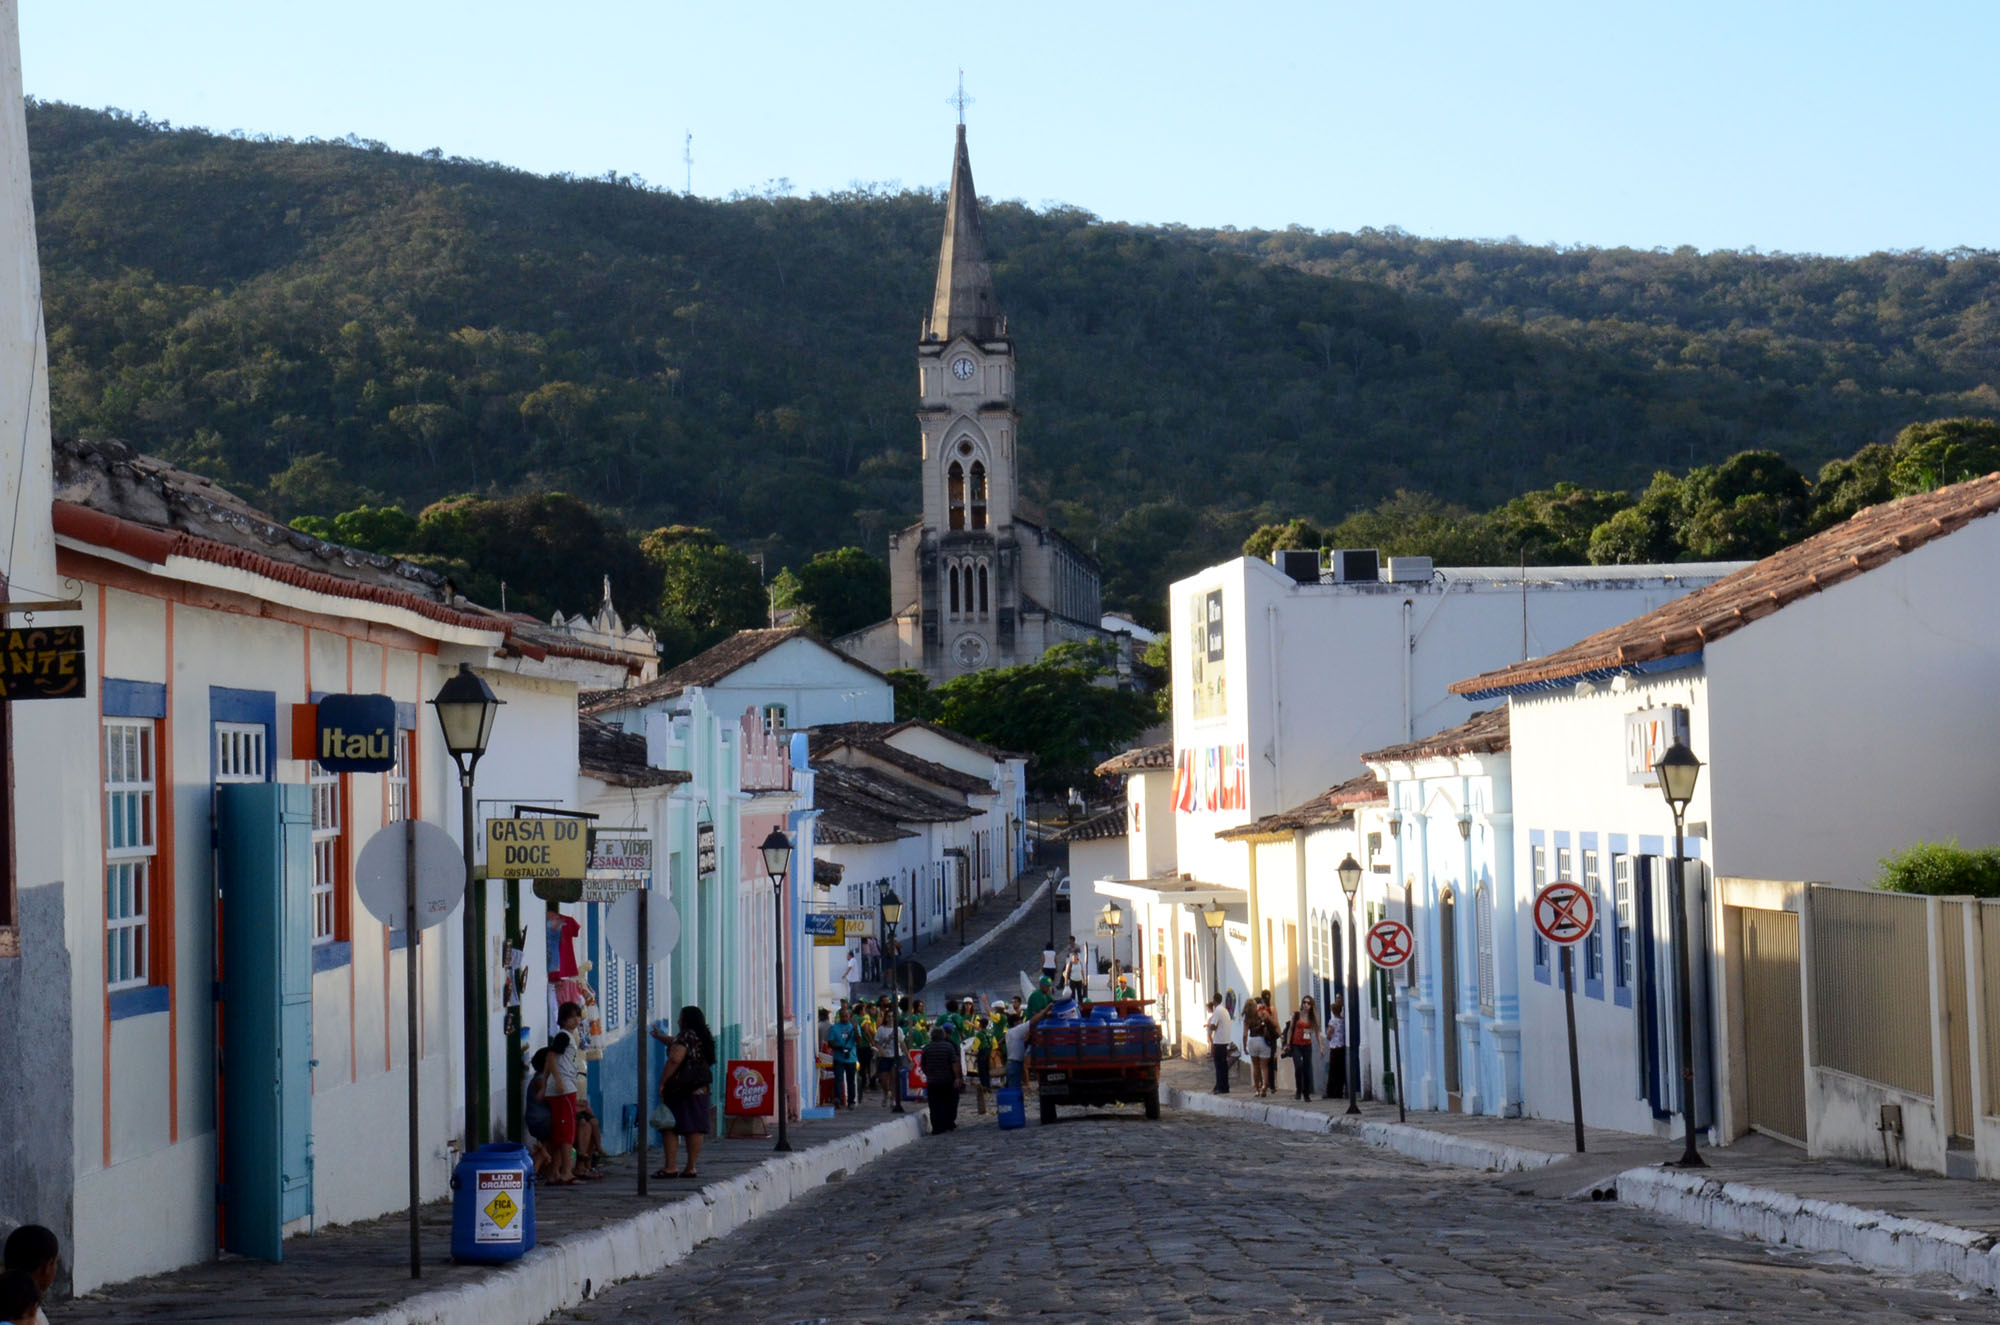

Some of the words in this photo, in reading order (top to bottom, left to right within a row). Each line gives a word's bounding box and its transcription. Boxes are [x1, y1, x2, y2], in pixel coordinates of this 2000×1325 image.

[322, 728, 390, 759] Itaú
[492, 821, 545, 841] CASA
[554, 821, 579, 841] DO
[505, 845, 551, 864] DOCE
[621, 840, 649, 856] VIDA
[592, 856, 645, 867] ESANATOS
[504, 868, 560, 878] CRISTALIZADO
[481, 1180, 521, 1190] ORGÂNICO
[494, 1200, 512, 1209] FICA
